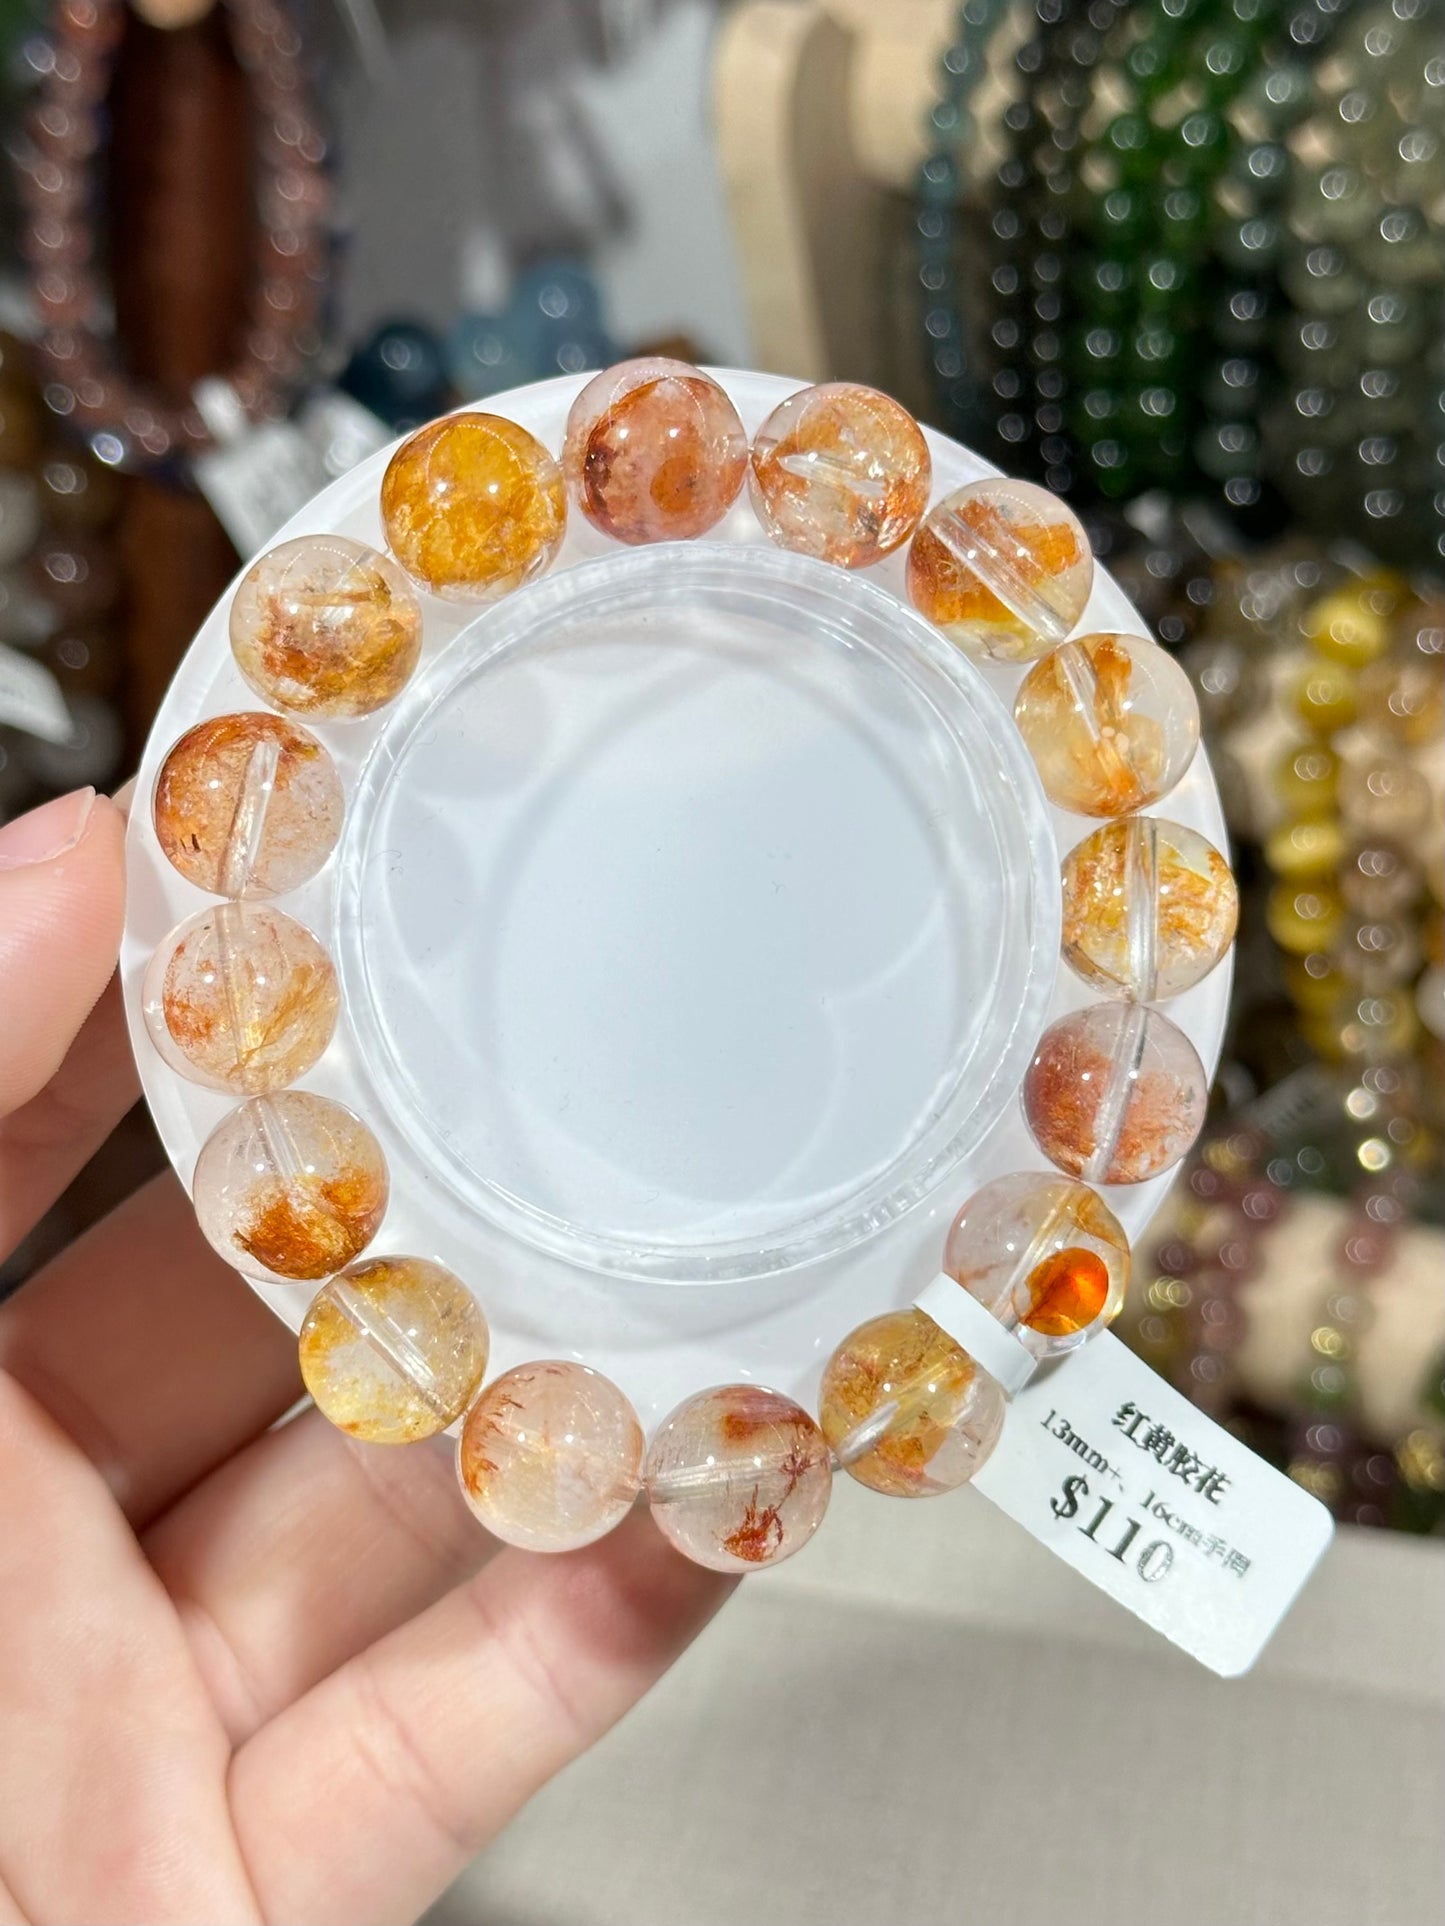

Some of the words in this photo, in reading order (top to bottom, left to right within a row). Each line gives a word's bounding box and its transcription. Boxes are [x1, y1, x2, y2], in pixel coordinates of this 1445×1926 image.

[1111, 1401, 1232, 1505] 红黄胶花
[1050, 1473, 1175, 1583] $110
